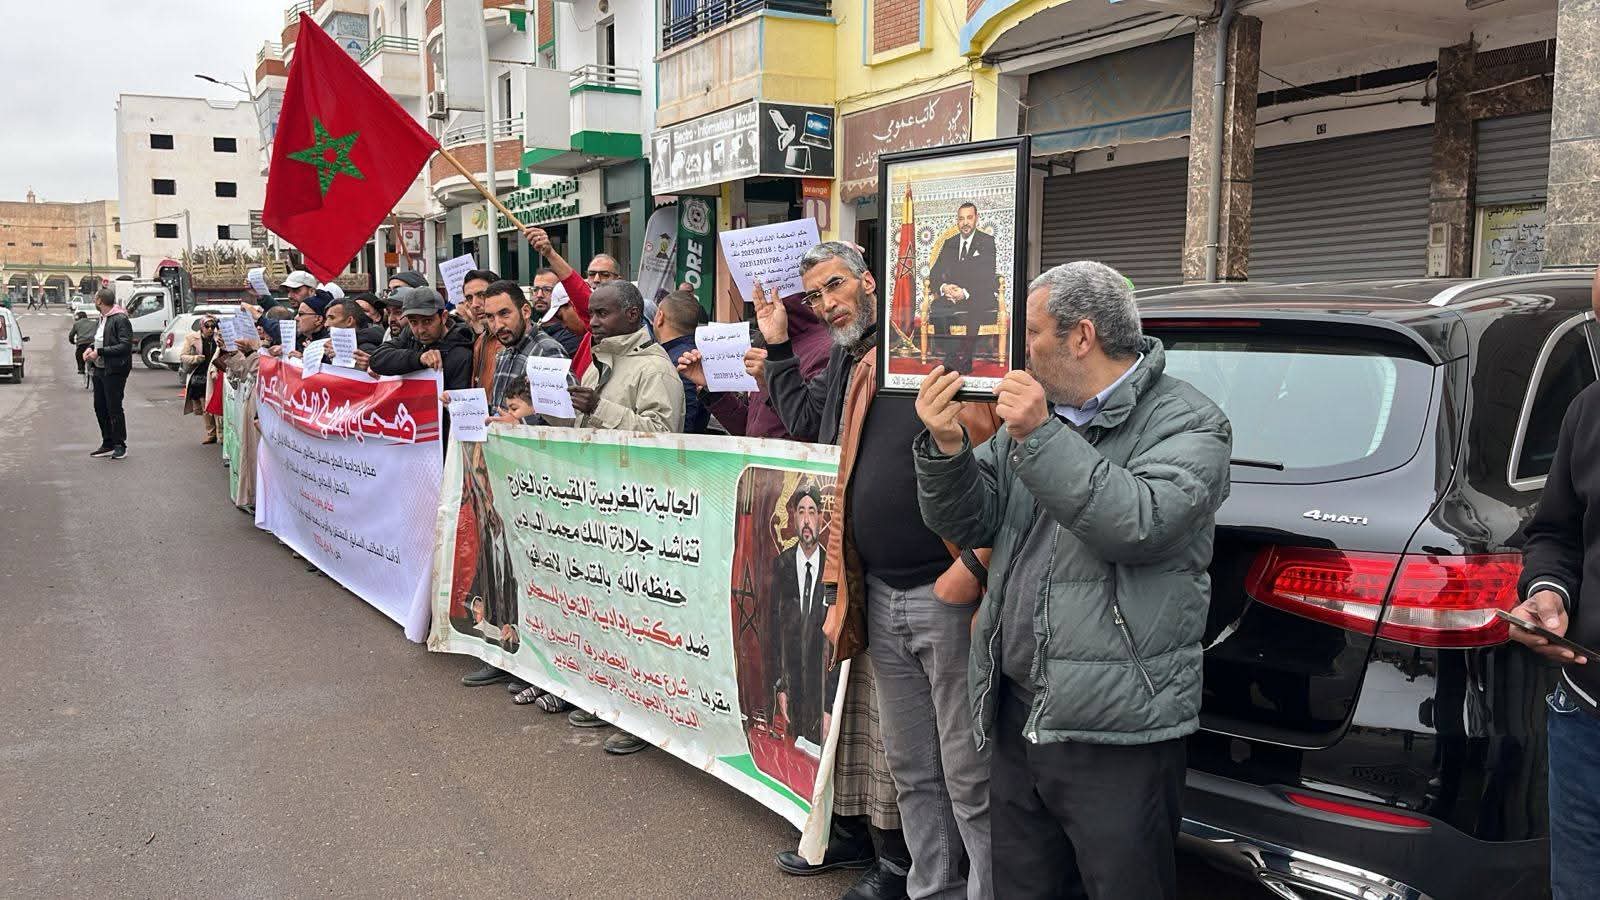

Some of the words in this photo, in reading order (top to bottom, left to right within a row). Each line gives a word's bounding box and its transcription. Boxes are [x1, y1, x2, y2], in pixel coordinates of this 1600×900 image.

[915, 96, 941, 128] كاتب
[873, 116, 915, 143] عمومي
[804, 186, 828, 195] orange
[507, 472, 543, 500] بالخارج
[543, 475, 587, 508] المقيمة
[590, 480, 644, 514] المغربية
[647, 488, 699, 522] الجالية
[1303, 510, 1368, 525] 4MATI
[515, 511, 545, 531] السادس
[548, 519, 580, 540] محمد
[582, 518, 608, 547] الملك
[610, 524, 654, 561] جلالة
[658, 534, 700, 565] تناشد
[565, 558, 611, 594] بالتدخل
[617, 565, 640, 594] الله
[641, 577, 687, 606] حفظه
[631, 616, 683, 643] مكتب
[686, 632, 710, 657] ضد
[663, 675, 689, 697] شارع
